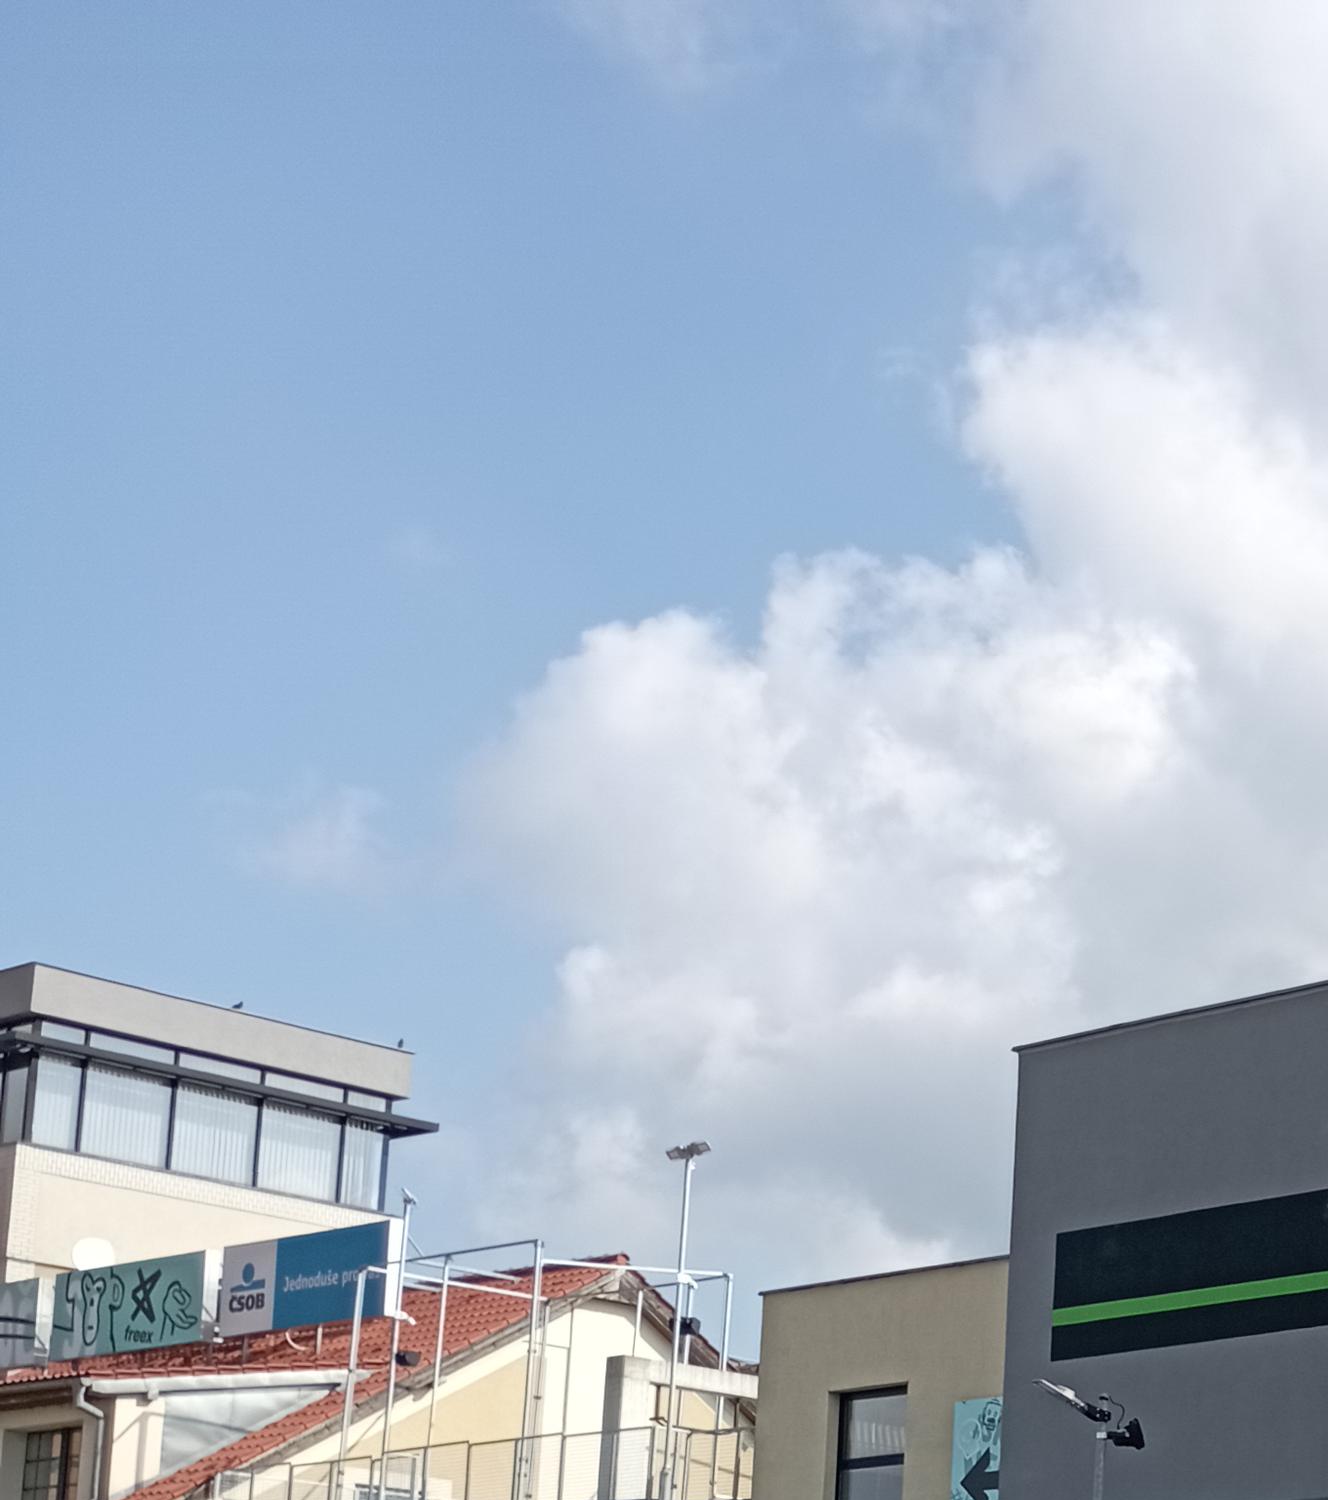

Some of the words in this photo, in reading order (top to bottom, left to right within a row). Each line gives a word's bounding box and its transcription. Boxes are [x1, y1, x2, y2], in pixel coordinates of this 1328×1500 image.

[283, 1269, 339, 1292] Jednoduše
[229, 1292, 265, 1313] ČSOB
[125, 1325, 153, 1344] freex
